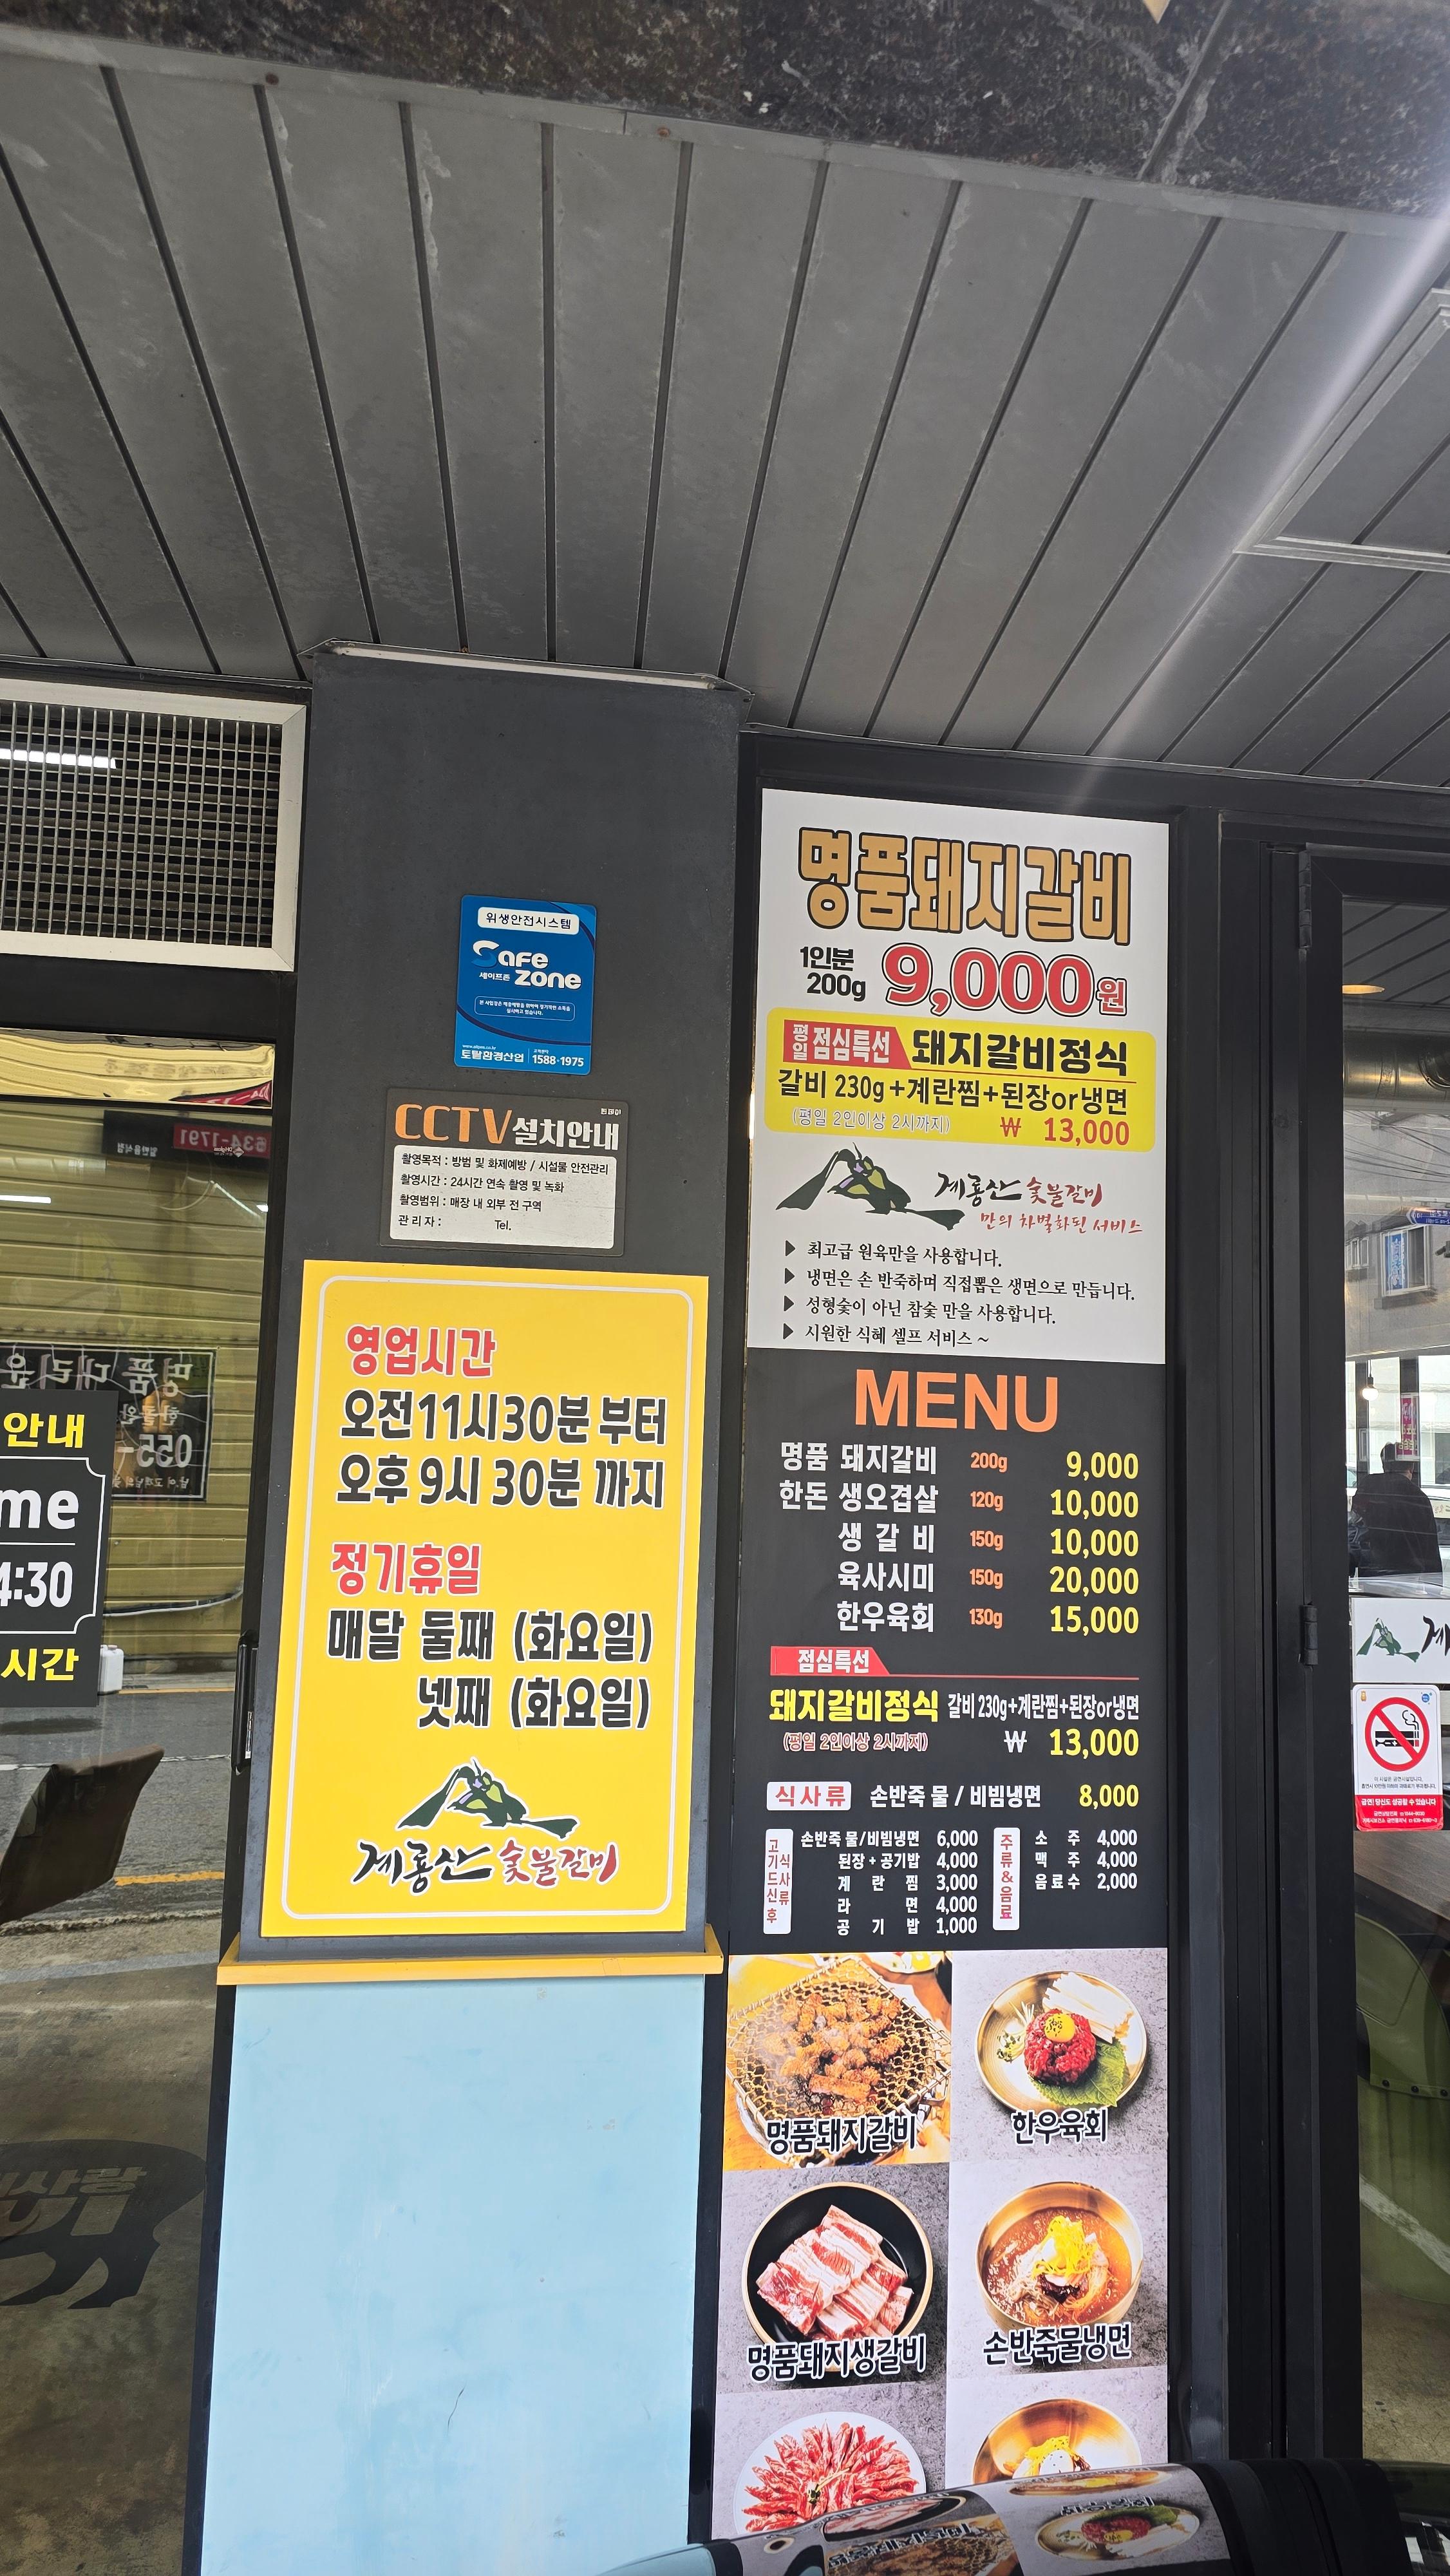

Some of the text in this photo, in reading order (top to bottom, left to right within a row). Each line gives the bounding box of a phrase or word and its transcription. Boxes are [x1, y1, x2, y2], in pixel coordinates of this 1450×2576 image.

[798, 828, 1131, 945] 명품돼지갈비
[486, 913, 571, 929] 위생안전시스템
[800, 947, 854, 969] 1인분
[479, 972, 510, 981] 세이프존
[807, 973, 866, 1001] 200g
[813, 1027, 1127, 1076] 점심특선 돼지갈비정식
[778, 1069, 826, 1098] 갈비
[793, 1108, 950, 1133] (평일 2인이상 2시까지)
[1044, 1117, 1129, 1146] 13,000
[402, 1153, 608, 1175] 촬영목적 방범 및 화제예방 시설물 안전관리
[400, 1173, 564, 1193] 촬영시간 24시간 연속 촬영 및 녹화
[935, 1172, 1102, 1208] 계룡산 숯불갈비
[400, 1194, 541, 1211] 촬영범위 매장 내 외부 전 구역
[495, 1220, 511, 1231] Tel.
[981, 1213, 1142, 1233] 만의 차별화된 서비스
[807, 1242, 1002, 1267] 최고급 원육만을 사용합니다.
[807, 1269, 1134, 1300] 냉면은 손 반죽하며 직접뽑은 생면으로 만듭니다.
[806, 1298, 1055, 1324] 성형숯이 아닌 참숯 만을 사용합니다.
[805, 1325, 972, 1347] 시원한 식혜 셀프 서비스
[344, 1325, 497, 1378] 영업시간
[855, 1369, 1058, 1433] MENU
[3, 1413, 84, 1448] 안내
[598, 1396, 667, 1446] 부터
[780, 1442, 1138, 1480] 명품 돼지갈비 200g 9,000
[335, 1454, 665, 1510] 오후 9시 30분 까지
[779, 1480, 1138, 1519] 한돈 생오겹살 120g 10,000
[970, 1528, 1138, 1557] 150g 10,000
[332, 1543, 482, 1595] 정기휴일
[837, 1562, 1138, 1595] 육사시미 150g 20,000
[837, 1601, 1138, 1636] 한우육회 130g 15,000
[328, 1609, 654, 1663] 매달 둘째 (화요일)
[1, 1648, 79, 1680] 시간
[798, 1649, 870, 1674] 점심특선
[418, 1678, 650, 1729] 넷째 (화요일)
[769, 1689, 938, 1723] 돼지갈비정식
[947, 1694, 975, 1719] 갈비
[783, 1732, 928, 1752] (평일 2인이상 2시까지)
[1050, 1728, 1138, 1759] 13,000
[870, 1785, 925, 1808] 손반죽
[931, 1785, 949, 1808] 물
[970, 1785, 1040, 1808] 비빔냉면
[1079, 1785, 1138, 1810] 8,000
[801, 1831, 841, 1848] 손반죽
[937, 1830, 978, 1848] 6,000
[1097, 1829, 1137, 1847] 4,000
[352, 1839, 620, 1894] 계룡산 숯불갈비
[838, 1852, 978, 1870] 된장 공기밥 4,000
[1097, 1851, 1137, 1869] 4,000
[936, 1874, 977, 1892] 3,000
[1097, 1873, 1137, 1891] 2,000
[936, 1896, 977, 1915] 4,000
[936, 1917, 977, 1935] 1,000
[766, 2112, 917, 2155] 명품돼지갈비
[1012, 2108, 1109, 2145] 한우육회
[747, 2334, 927, 2382] 명품돼지생갈비
[983, 2324, 1132, 2365] 손반죽물냉면
